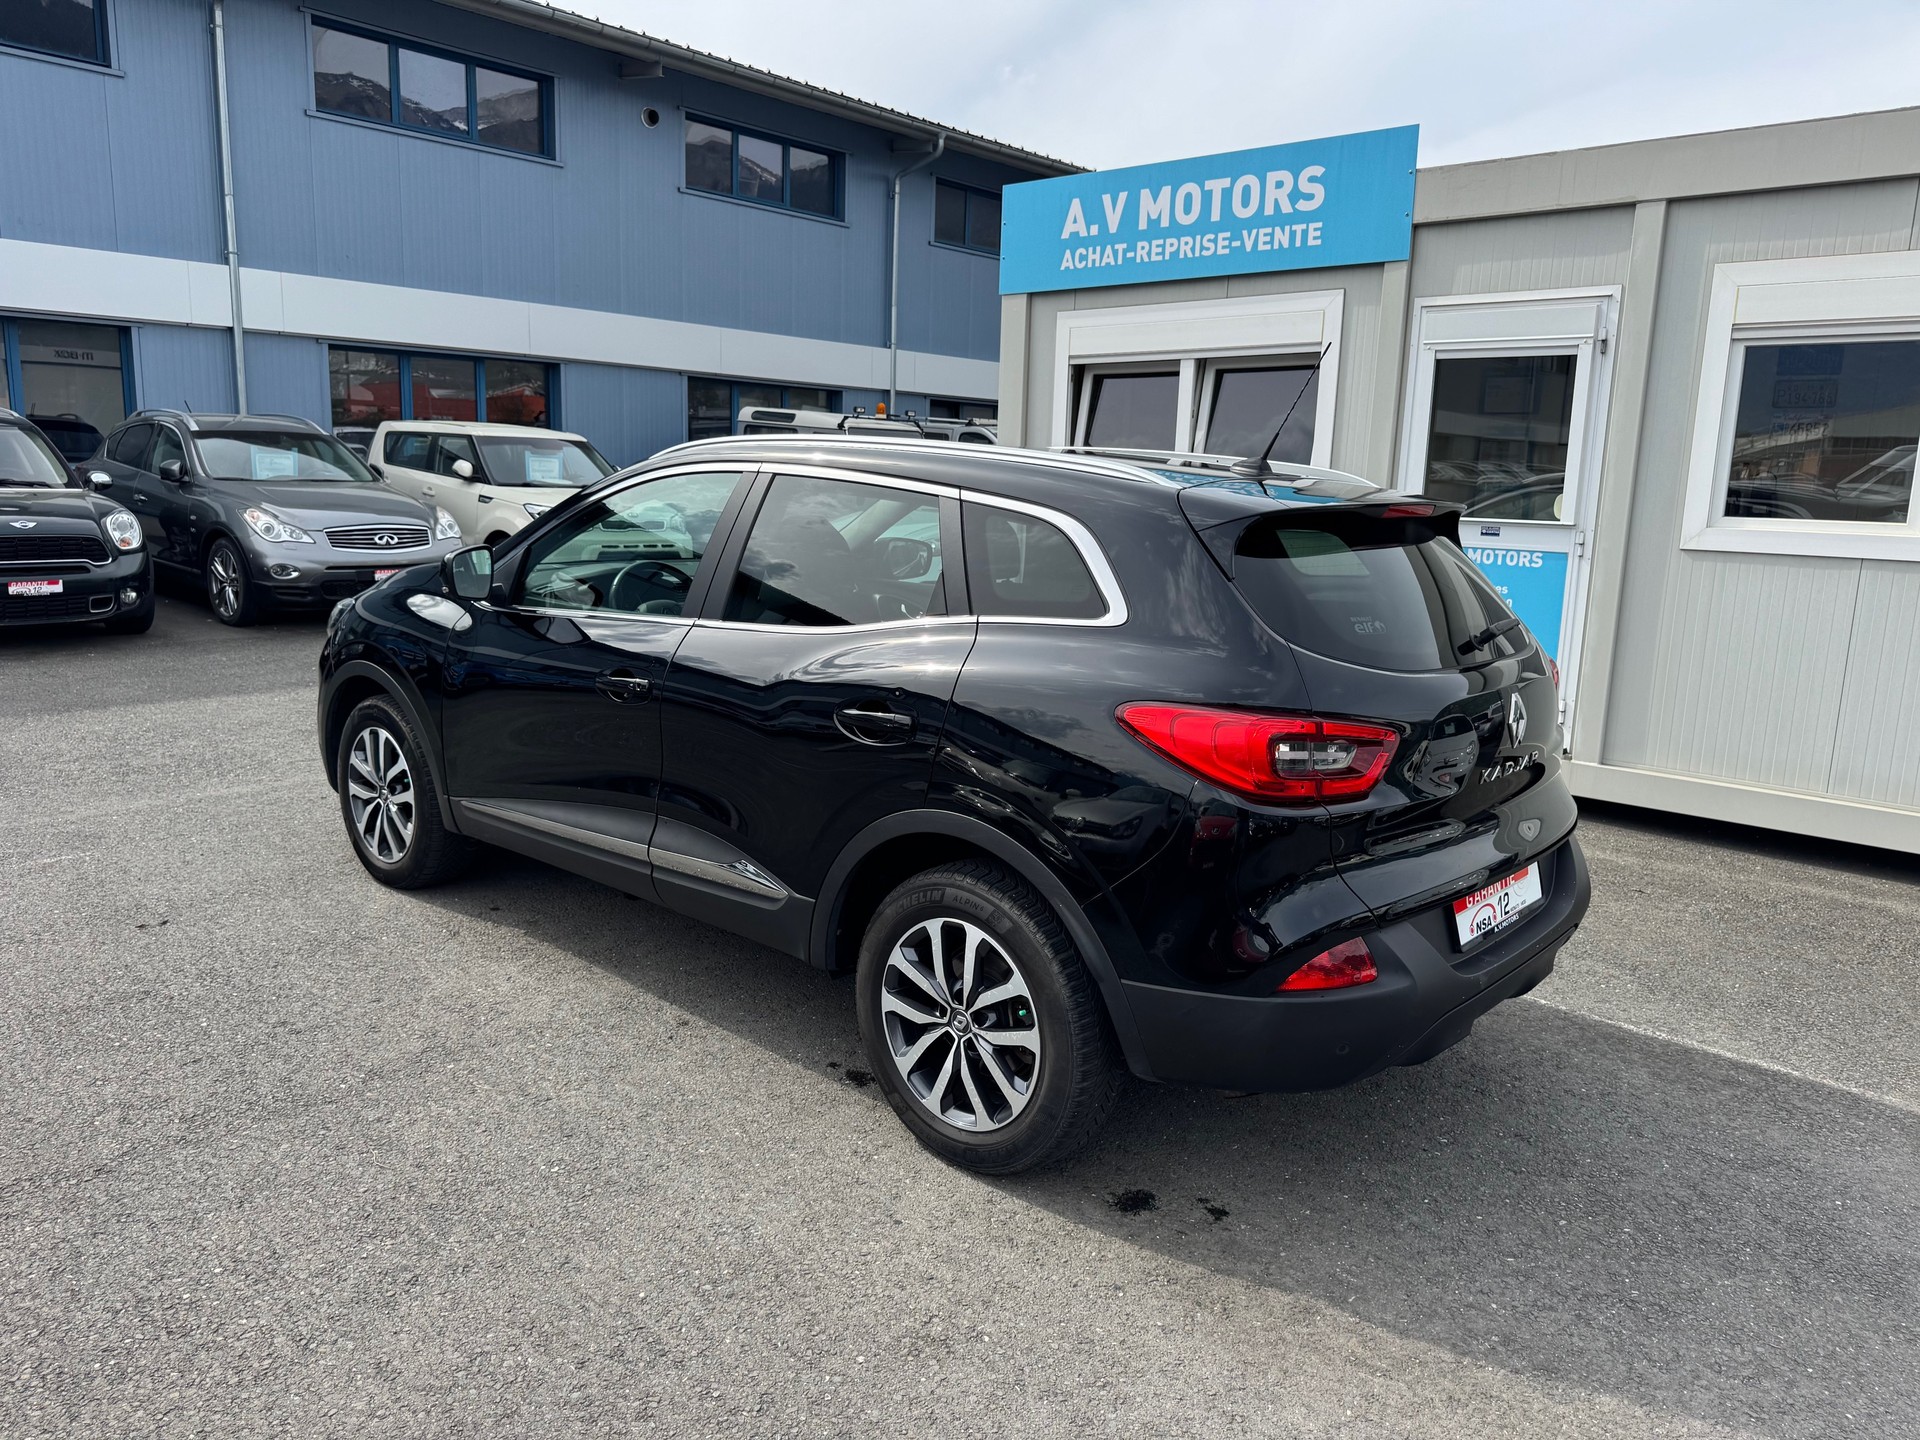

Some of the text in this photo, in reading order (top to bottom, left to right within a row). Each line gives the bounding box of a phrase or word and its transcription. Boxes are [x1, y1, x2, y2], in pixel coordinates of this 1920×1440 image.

[1060, 165, 1326, 239] A.V MOTORS
[1060, 221, 1324, 271] ACHAT-REPRISE-VENTE
[1467, 548, 1543, 568] MOTORS
[1479, 750, 1539, 785] KADJAR
[1476, 915, 1493, 935] NSA
[1498, 892, 1511, 919] 12
